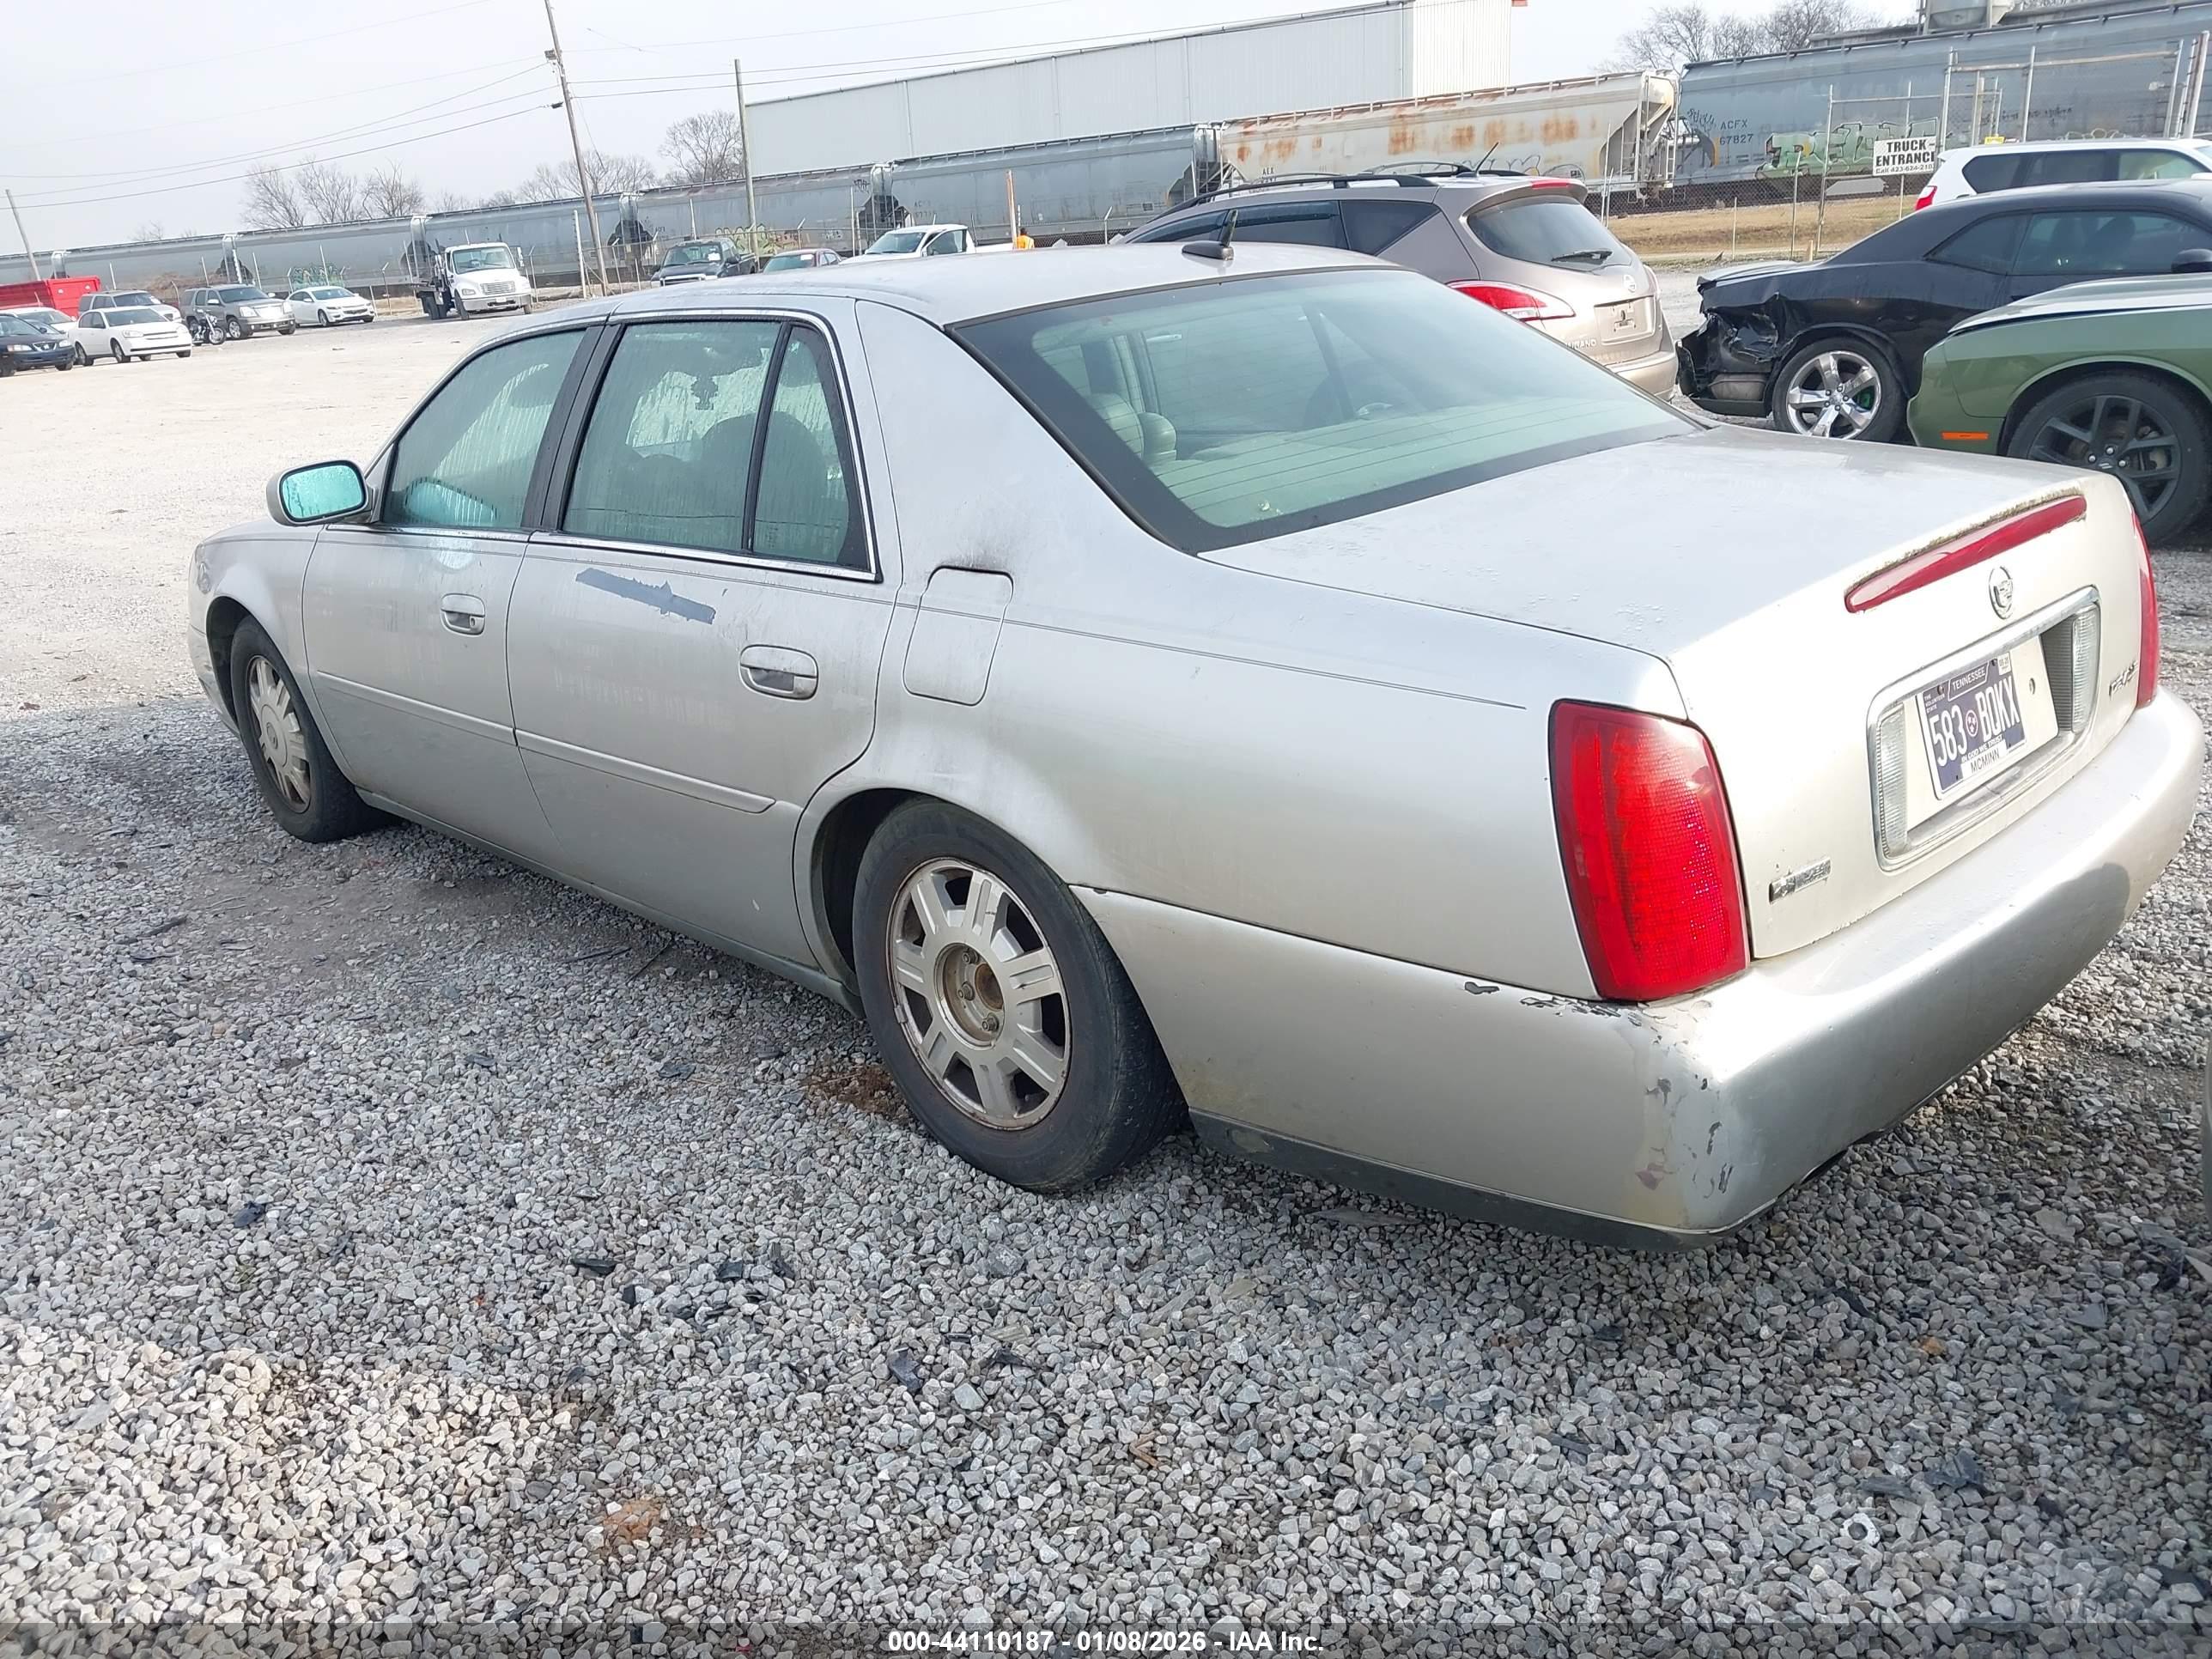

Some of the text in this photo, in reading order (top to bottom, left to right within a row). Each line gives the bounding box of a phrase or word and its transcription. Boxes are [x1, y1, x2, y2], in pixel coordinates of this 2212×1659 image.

[1721, 119, 1747, 131] ACFX
[1720, 134, 1753, 145] 67827
[1887, 139, 1927, 153] TRUCK
[1952, 666, 1986, 690] TENNESSEE
[1929, 675, 2020, 767] 583 BQKX
[1967, 748, 1979, 759] GOD
[1978, 743, 1987, 753] WE
[1988, 734, 2002, 748] TRUST
[1971, 747, 2000, 773] MCMINN
